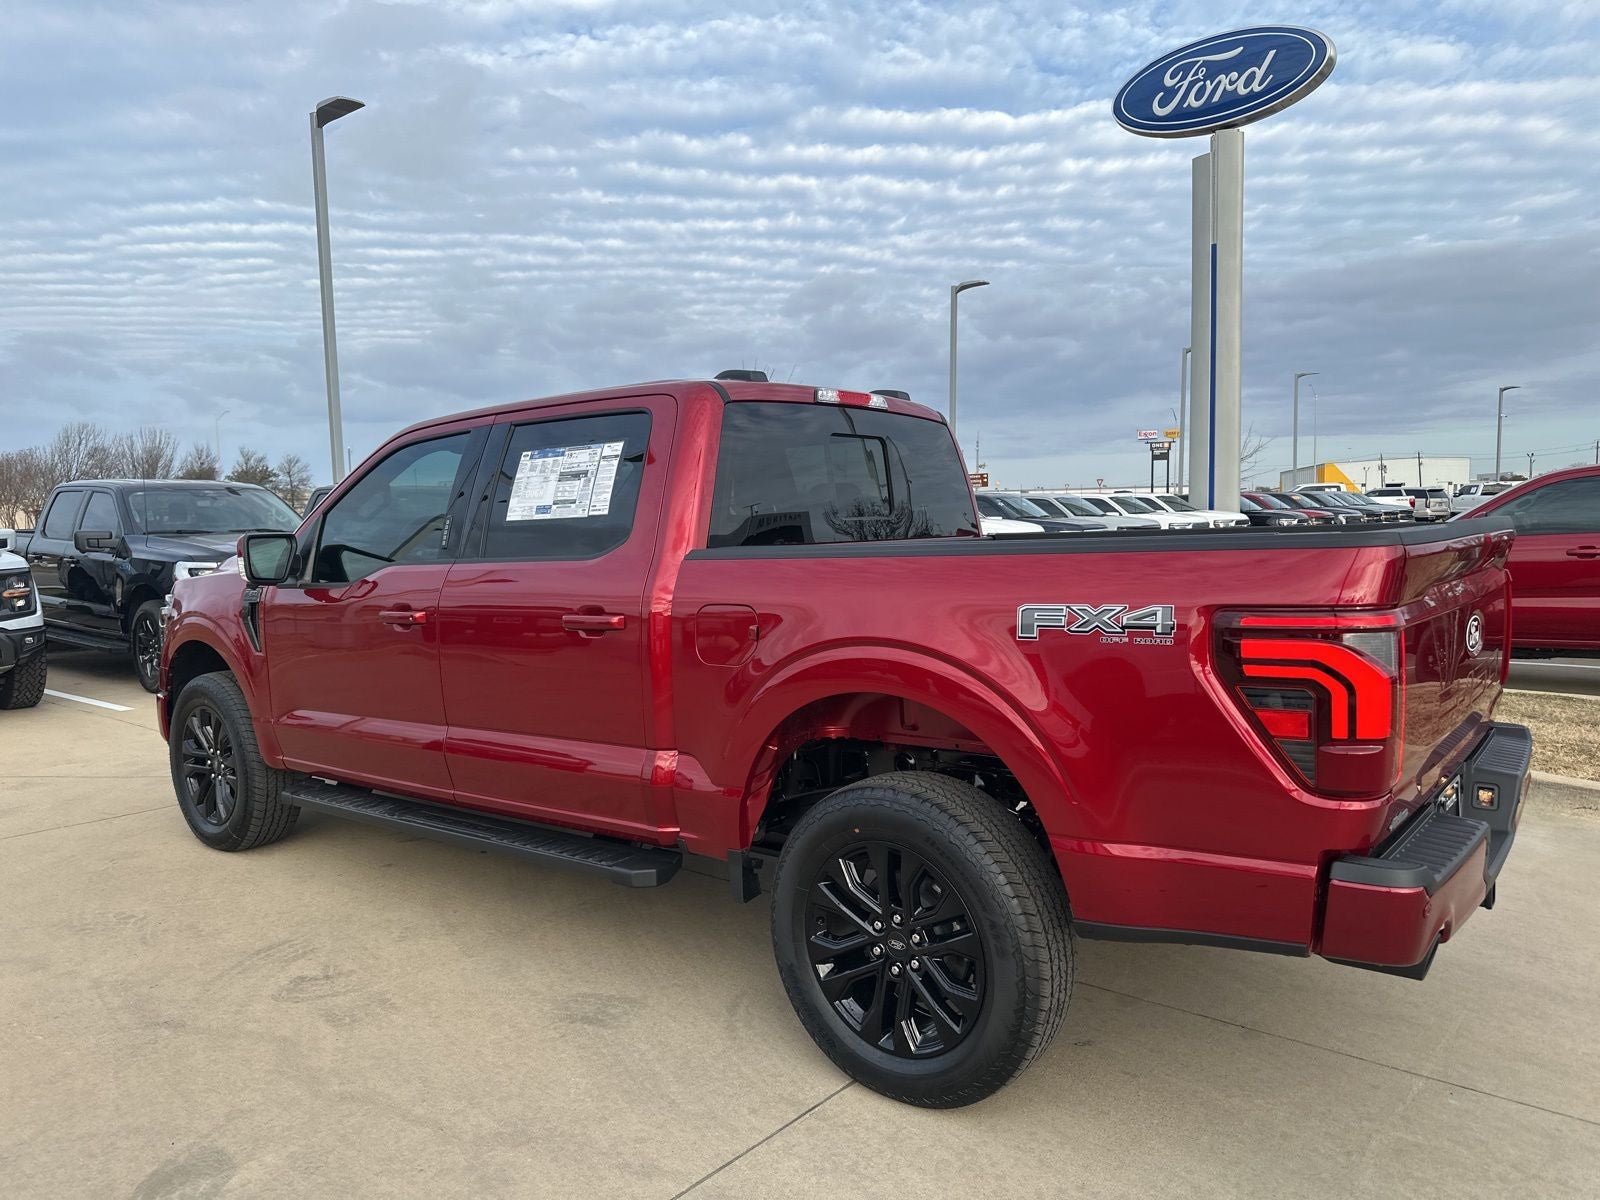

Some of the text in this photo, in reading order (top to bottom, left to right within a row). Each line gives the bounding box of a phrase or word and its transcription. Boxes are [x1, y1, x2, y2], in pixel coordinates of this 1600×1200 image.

[1152, 46, 1277, 117] Ford
[1017, 604, 1176, 640] FX4
[1134, 637, 1174, 645] ROAD
